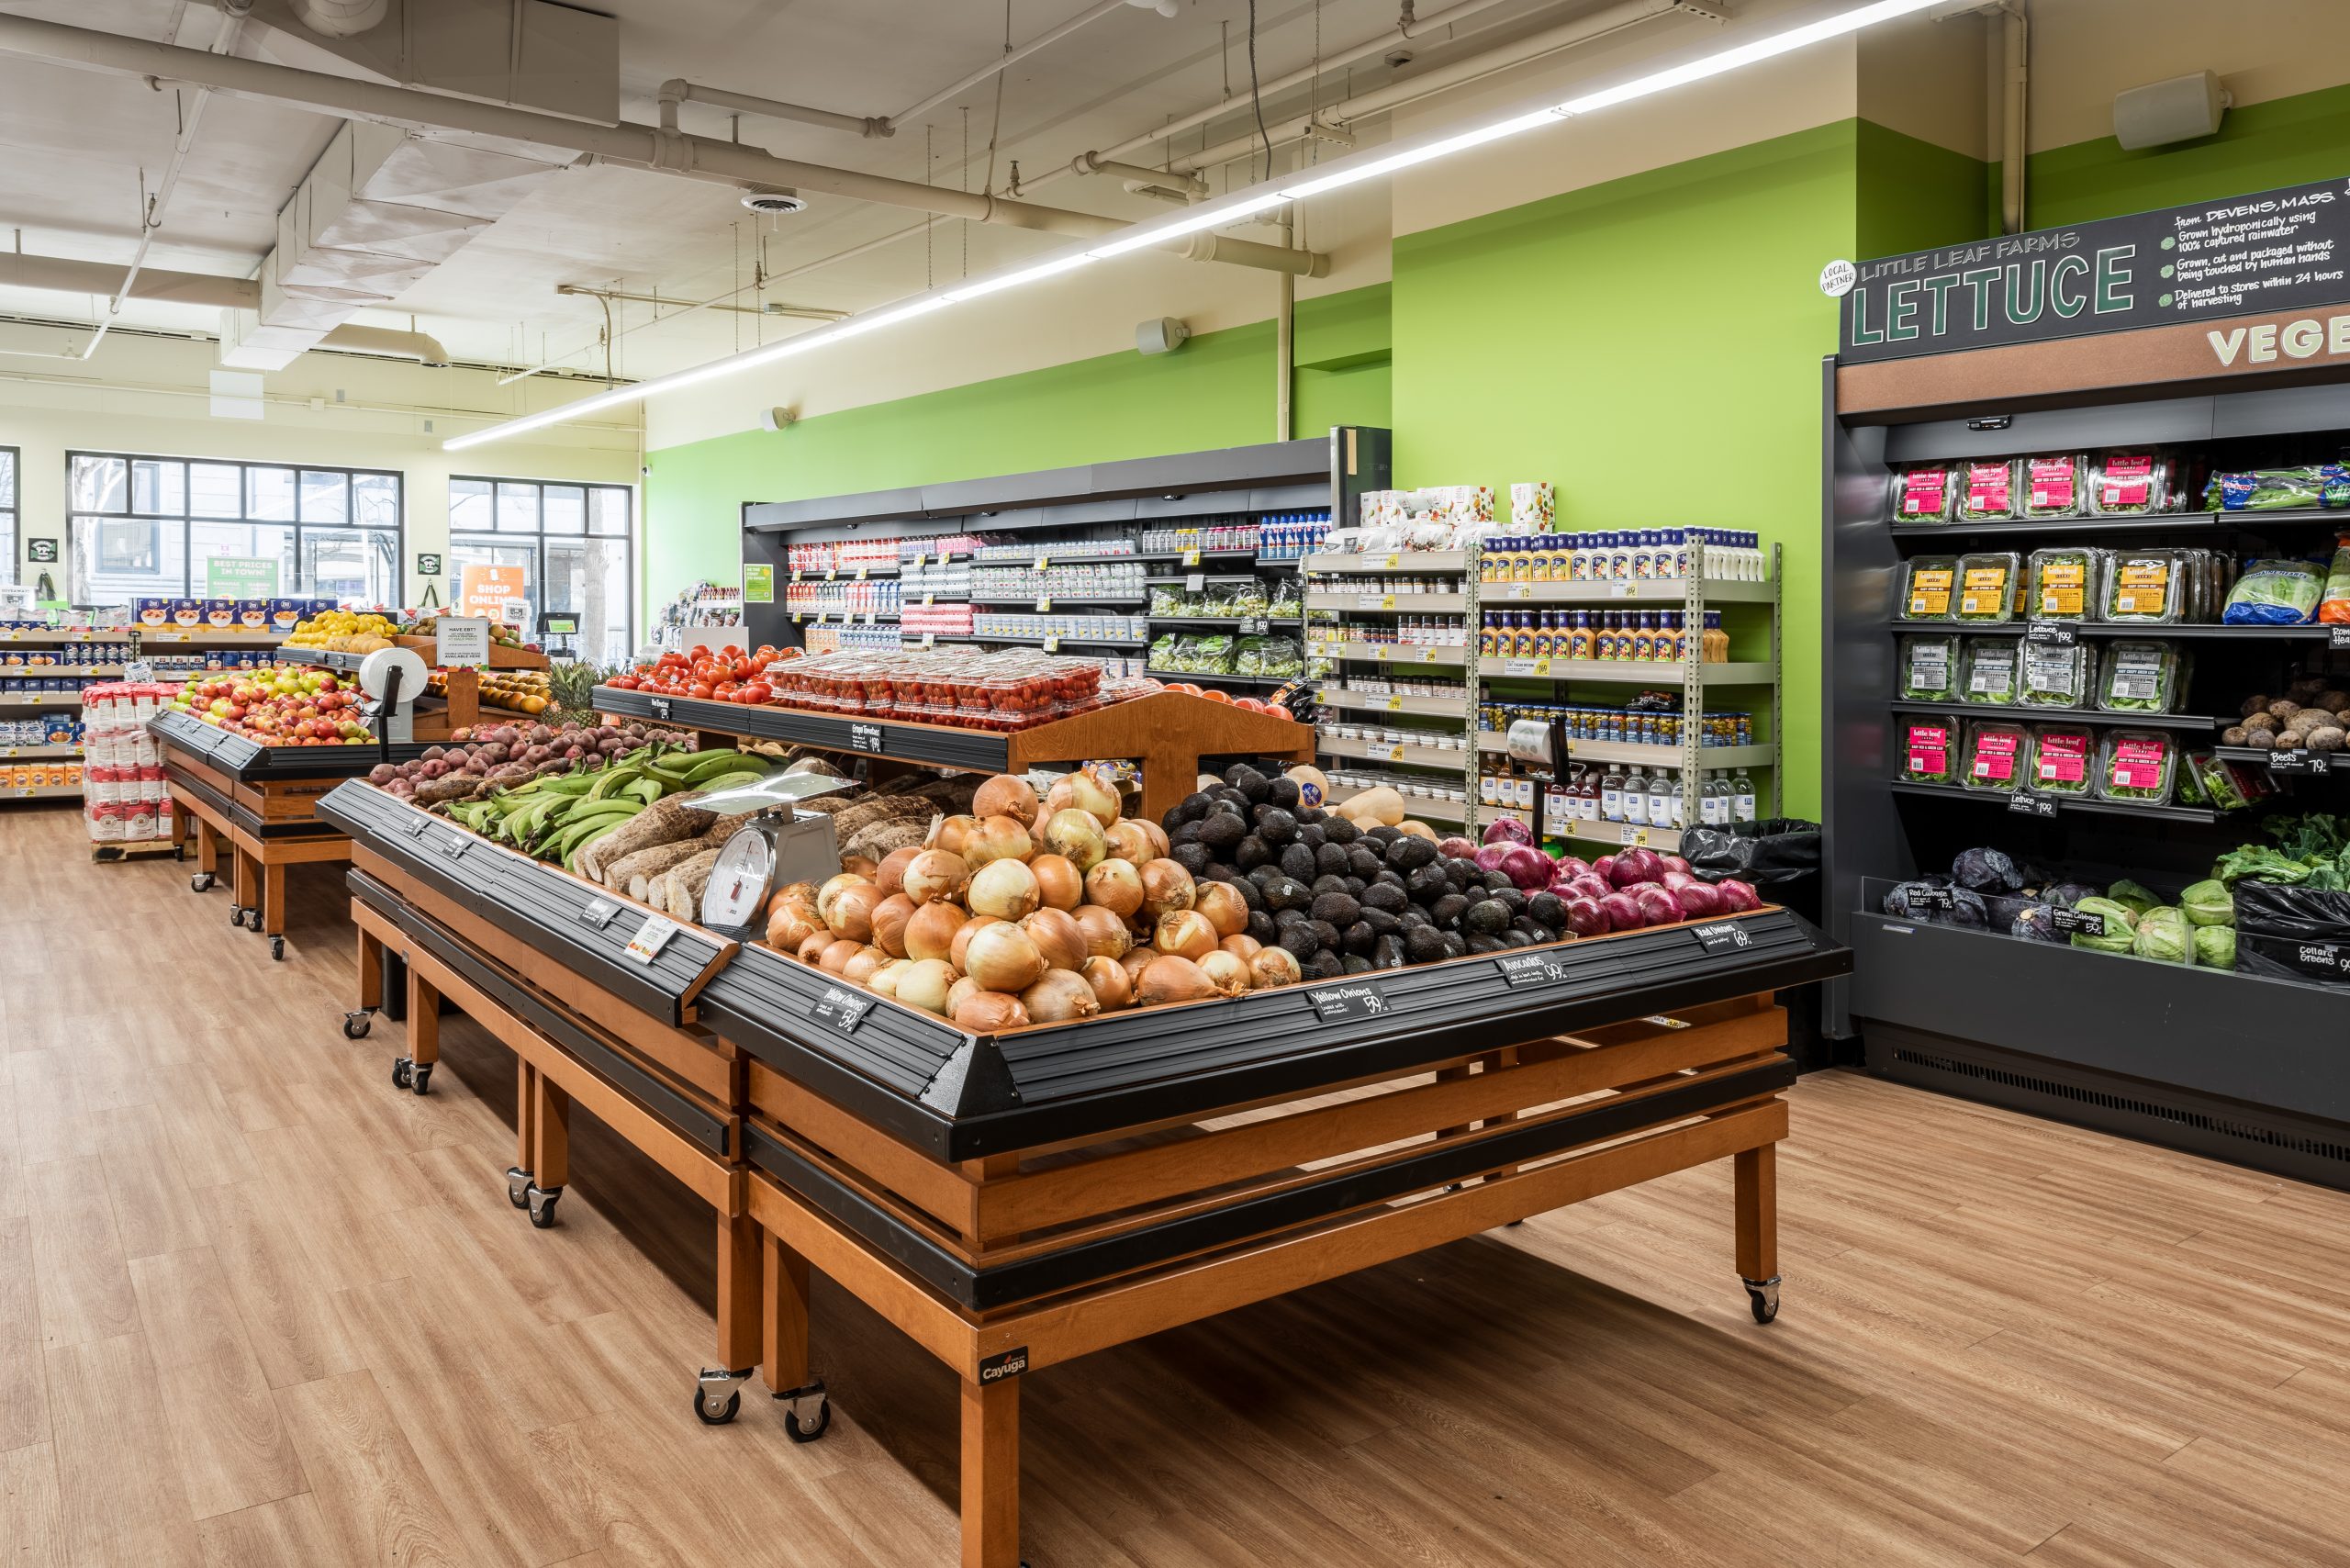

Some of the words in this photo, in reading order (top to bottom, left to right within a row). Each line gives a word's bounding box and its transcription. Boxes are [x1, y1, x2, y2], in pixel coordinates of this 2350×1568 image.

[2175, 216, 2202, 230] from
[2281, 192, 2336, 209] MASS.
[2178, 229, 2209, 241] Grown
[2211, 216, 2286, 237] hydroponically
[2288, 211, 2316, 224] using
[2177, 240, 2200, 252] 100%
[2204, 233, 2244, 249] captured
[2248, 225, 2299, 241] rainwater
[1860, 256, 1929, 282] LITTLE
[1933, 245, 1991, 271] LEAF
[1996, 231, 2081, 260] FARMS
[2177, 258, 2210, 271] Grown,
[2213, 253, 2227, 264] cut
[2230, 251, 2248, 263] and
[2251, 244, 2293, 262] packaged
[2296, 239, 2335, 252] without
[1822, 263, 1850, 280] LOCAL
[2177, 269, 2204, 283] being
[2203, 262, 2243, 277] touched
[2244, 260, 2257, 272] by
[2260, 255, 2296, 269] human
[2298, 250, 2331, 263] hands
[1821, 272, 1854, 292] PARTNER
[2174, 286, 2216, 302] Delivered
[2217, 285, 2229, 295] to
[2230, 281, 2260, 294] stores
[2262, 276, 2292, 288] within
[2295, 272, 2311, 284] 24
[2314, 270, 2344, 281] hours
[1852, 244, 2137, 347] LETTUCE
[2177, 301, 2187, 310] of
[2191, 293, 2243, 308] harvesting
[2245, 569, 2278, 581] ROMAINE
[2278, 570, 2308, 579] HEARTS
[477, 585, 510, 593] SHOP
[2028, 625, 2057, 633] Lettuce
[1929, 730, 1942, 738] leaf
[2143, 744, 2158, 752] leaf
[2270, 752, 2297, 763] Beets
[2011, 795, 2035, 805] Lettuce
[2053, 909, 2074, 918] Green
[2074, 912, 2102, 923] Cabbage
[1695, 927, 1713, 937] Red
[1709, 924, 1736, 935] Onions
[2300, 946, 2333, 958] Collard
[2300, 954, 2334, 966] Greens
[1502, 956, 1545, 971] Avocados
[842, 994, 867, 1012] Onions
[1311, 991, 1342, 1003] Yellow
[1340, 987, 1372, 1000] Onions
[982, 1360, 1025, 1380] Cayuga
